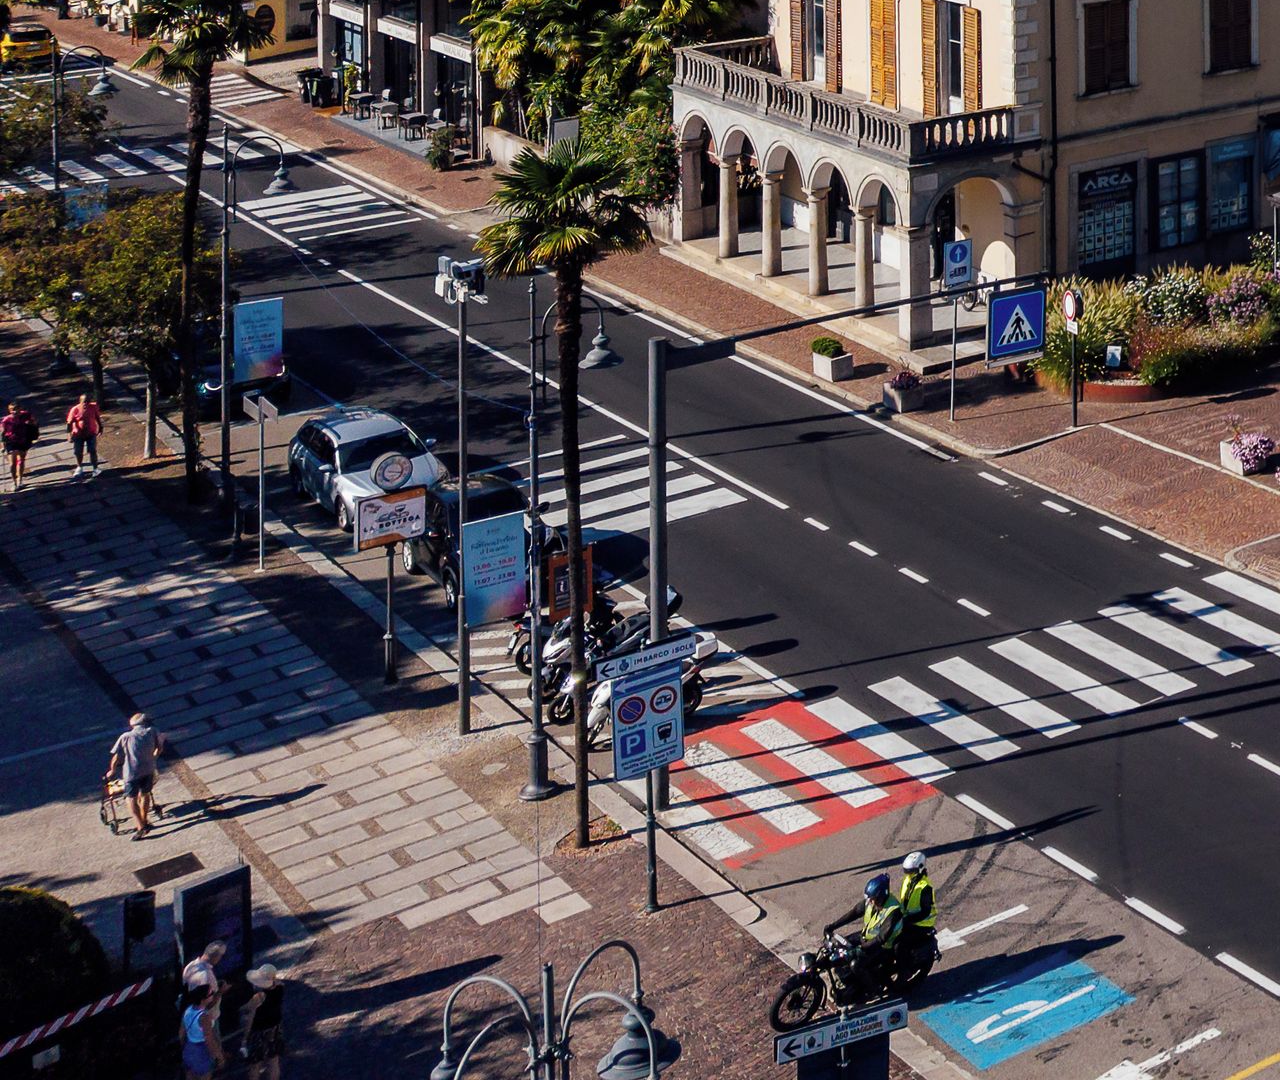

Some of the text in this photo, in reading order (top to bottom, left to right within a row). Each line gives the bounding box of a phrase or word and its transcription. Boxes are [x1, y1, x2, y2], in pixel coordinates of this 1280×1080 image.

[1084, 172, 1133, 192] ARCA
[379, 514, 421, 529] BOTTEGA
[633, 641, 695, 667] IMBARCO ISOLE
[626, 733, 641, 755] P
[831, 1031, 849, 1042] LAGO
